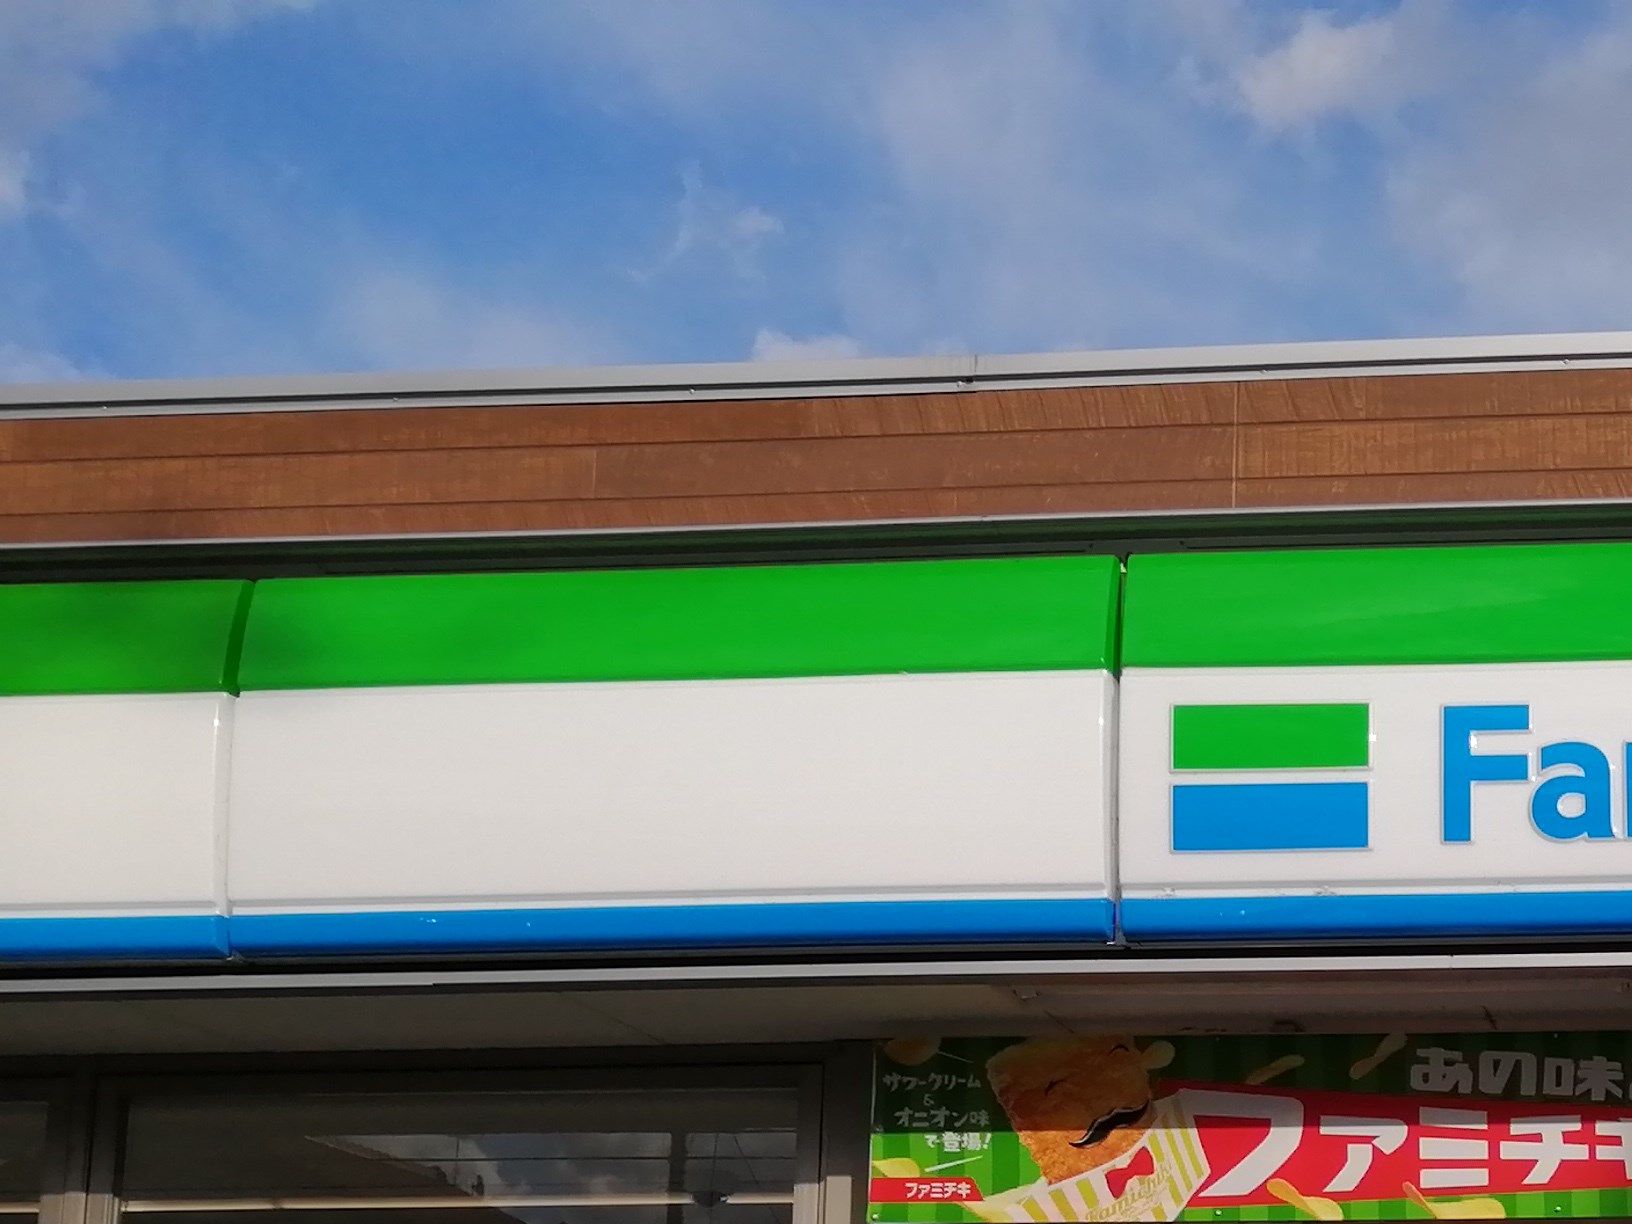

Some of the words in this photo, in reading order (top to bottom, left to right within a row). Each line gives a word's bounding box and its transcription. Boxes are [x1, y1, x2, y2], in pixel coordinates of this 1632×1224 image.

[883, 1073, 981, 1089] サワークリーム
[894, 1107, 990, 1128] オニオン味
[905, 1183, 971, 1199] ファミチキ
